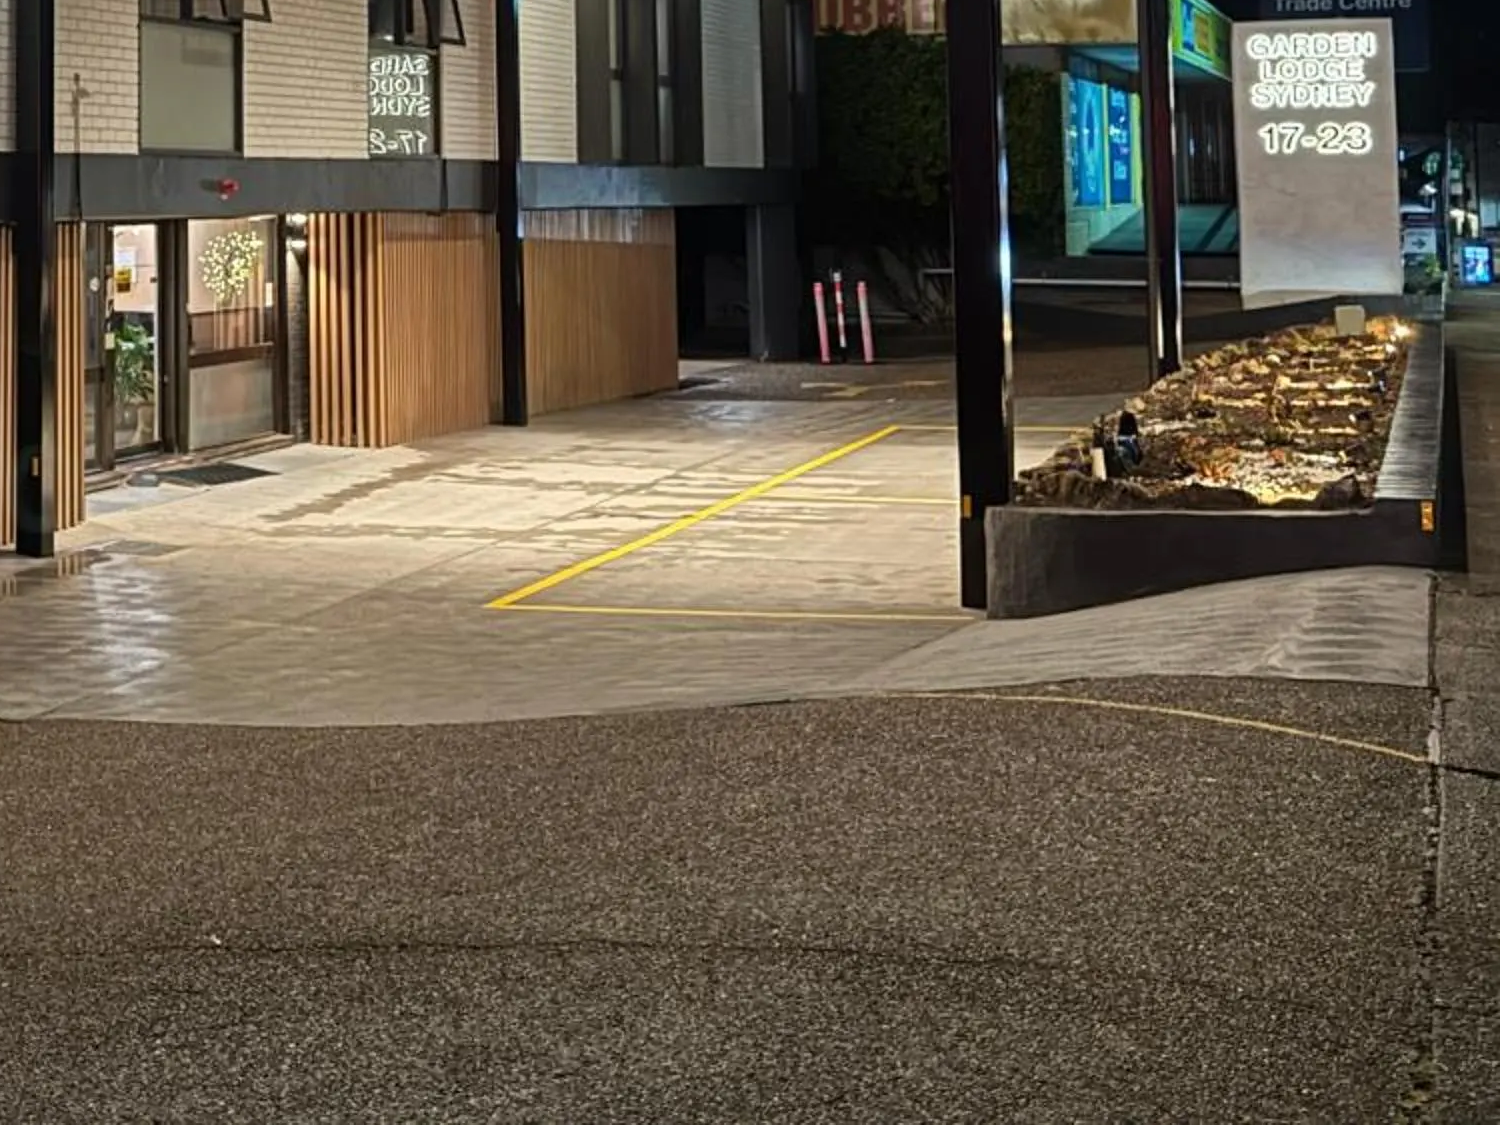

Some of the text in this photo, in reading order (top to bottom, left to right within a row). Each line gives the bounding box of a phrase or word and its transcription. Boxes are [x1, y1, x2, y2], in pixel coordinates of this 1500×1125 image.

[1247, 32, 1377, 59] GARDEN
[1259, 59, 1366, 83] LODGE
[1250, 81, 1376, 108] SYDNEY
[1257, 122, 1373, 154] 17-23
